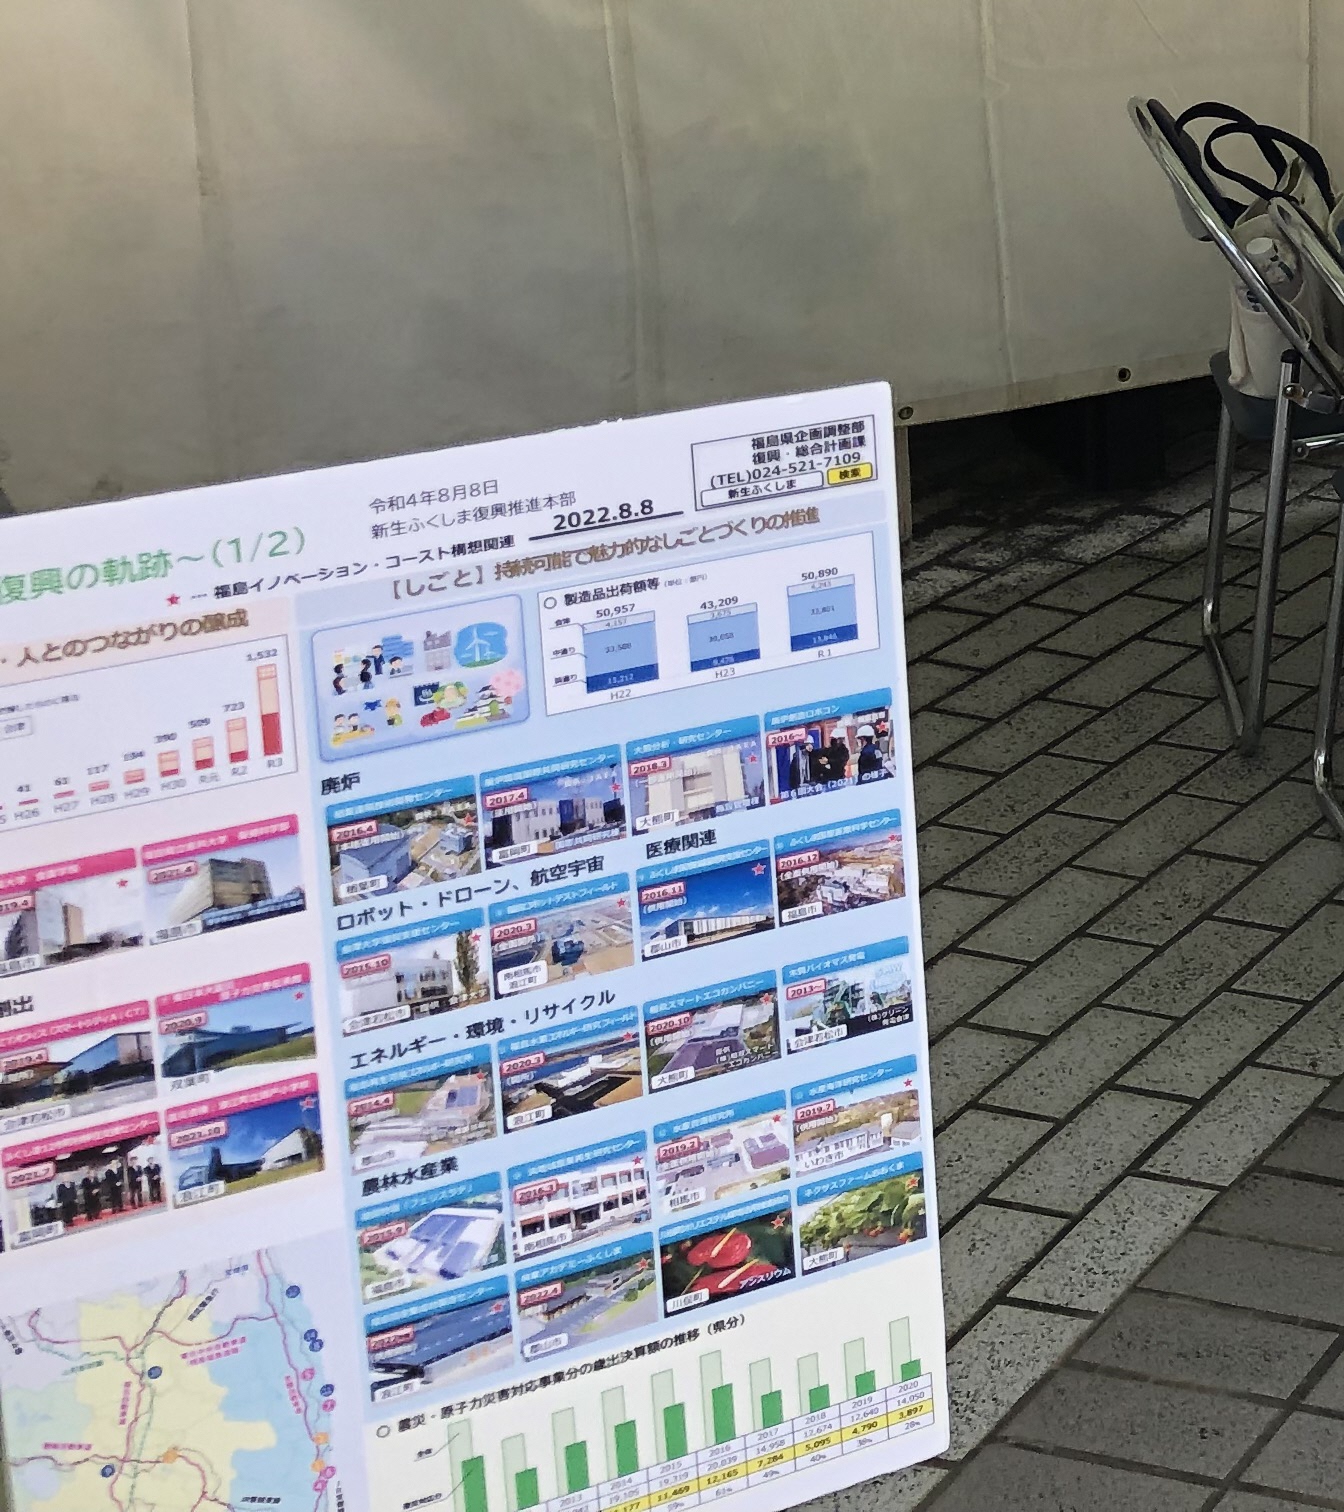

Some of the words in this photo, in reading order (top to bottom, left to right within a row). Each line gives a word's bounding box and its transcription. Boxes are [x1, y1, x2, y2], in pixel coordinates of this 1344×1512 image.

[751, 420, 866, 451] 福島県企画調整部
[838, 466, 862, 481] 検索
[368, 479, 500, 515] 令和4年8月8日
[727, 478, 797, 500] 新生ふくしま
[370, 490, 577, 540] 新生ふくしま復興推進本部
[552, 498, 654, 532] 2022.8.8
[800, 566, 839, 582] 50,890
[563, 576, 660, 608] 製造品出荷額等
[699, 595, 740, 611] 43,209
[595, 603, 636, 620] 50,957
[714, 667, 737, 680] H23
[609, 688, 632, 701] H22
[632, 760, 668, 775] 2018.3
[321, 771, 361, 796] 廃炉
[487, 790, 526, 805] 2017.4
[335, 824, 375, 841] 2016.4
[646, 828, 718, 860] 医療関連
[336, 854, 605, 931] ロボット・ドローン、航空宇宙
[349, 989, 616, 1071] エネルギー・環境・リサイクル
[650, 1015, 690, 1033] 2020.10
[505, 1056, 542, 1073] 2020.3
[799, 1103, 833, 1119] 2019.7
[661, 1141, 697, 1157] 2019.2
[362, 1155, 459, 1198] 農林水産業
[898, 1379, 919, 1394] 2020
[851, 1395, 873, 1409] 2019
[805, 1411, 827, 1425] 2018
[898, 1404, 924, 1420] 3,897
[757, 1427, 779, 1441] 2017
[851, 1421, 878, 1435] 4,790
[708, 1444, 732, 1459] 2016
[805, 1436, 832, 1452] 5,095
